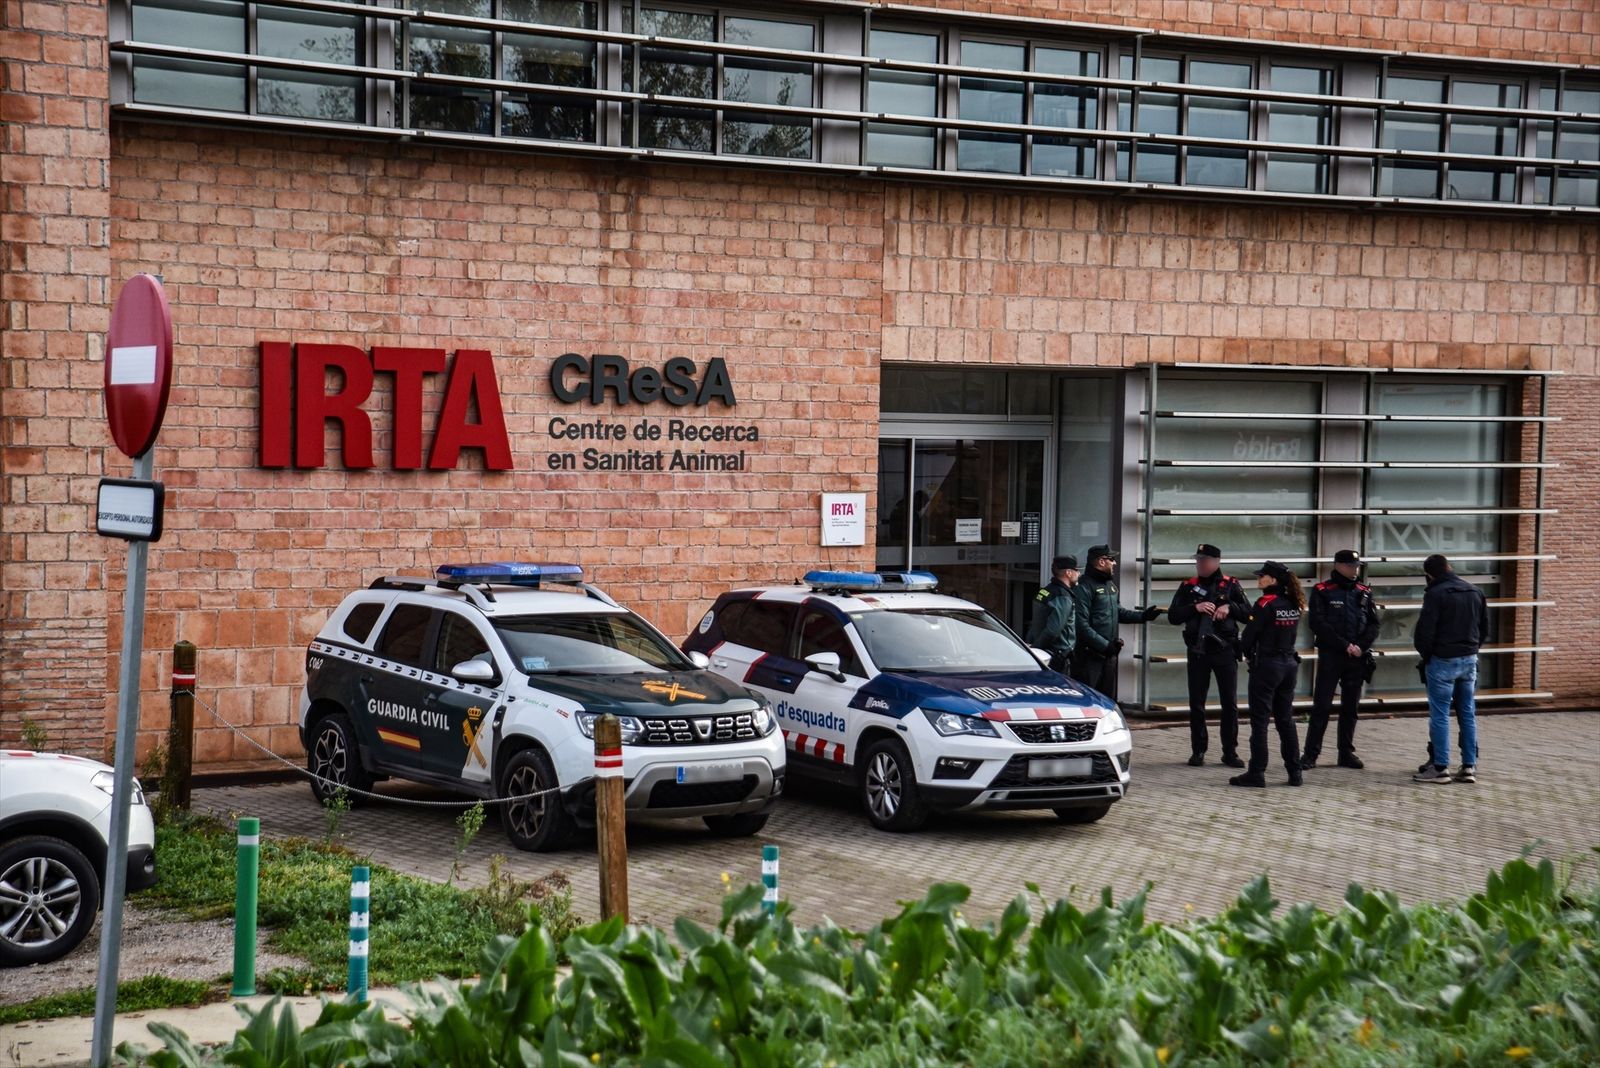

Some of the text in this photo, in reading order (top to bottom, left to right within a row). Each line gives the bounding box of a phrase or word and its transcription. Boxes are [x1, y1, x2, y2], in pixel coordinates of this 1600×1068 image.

[550, 353, 738, 407] CReSA
[259, 341, 514, 471] IRTA
[548, 417, 760, 443] Centre de Recerca
[548, 447, 746, 472] en Sanitat Animal
[831, 503, 854, 516] IRTA
[998, 685, 1084, 698] policia
[367, 698, 450, 731] GUARDIA CIVIL
[777, 703, 846, 733] d'esquadra
